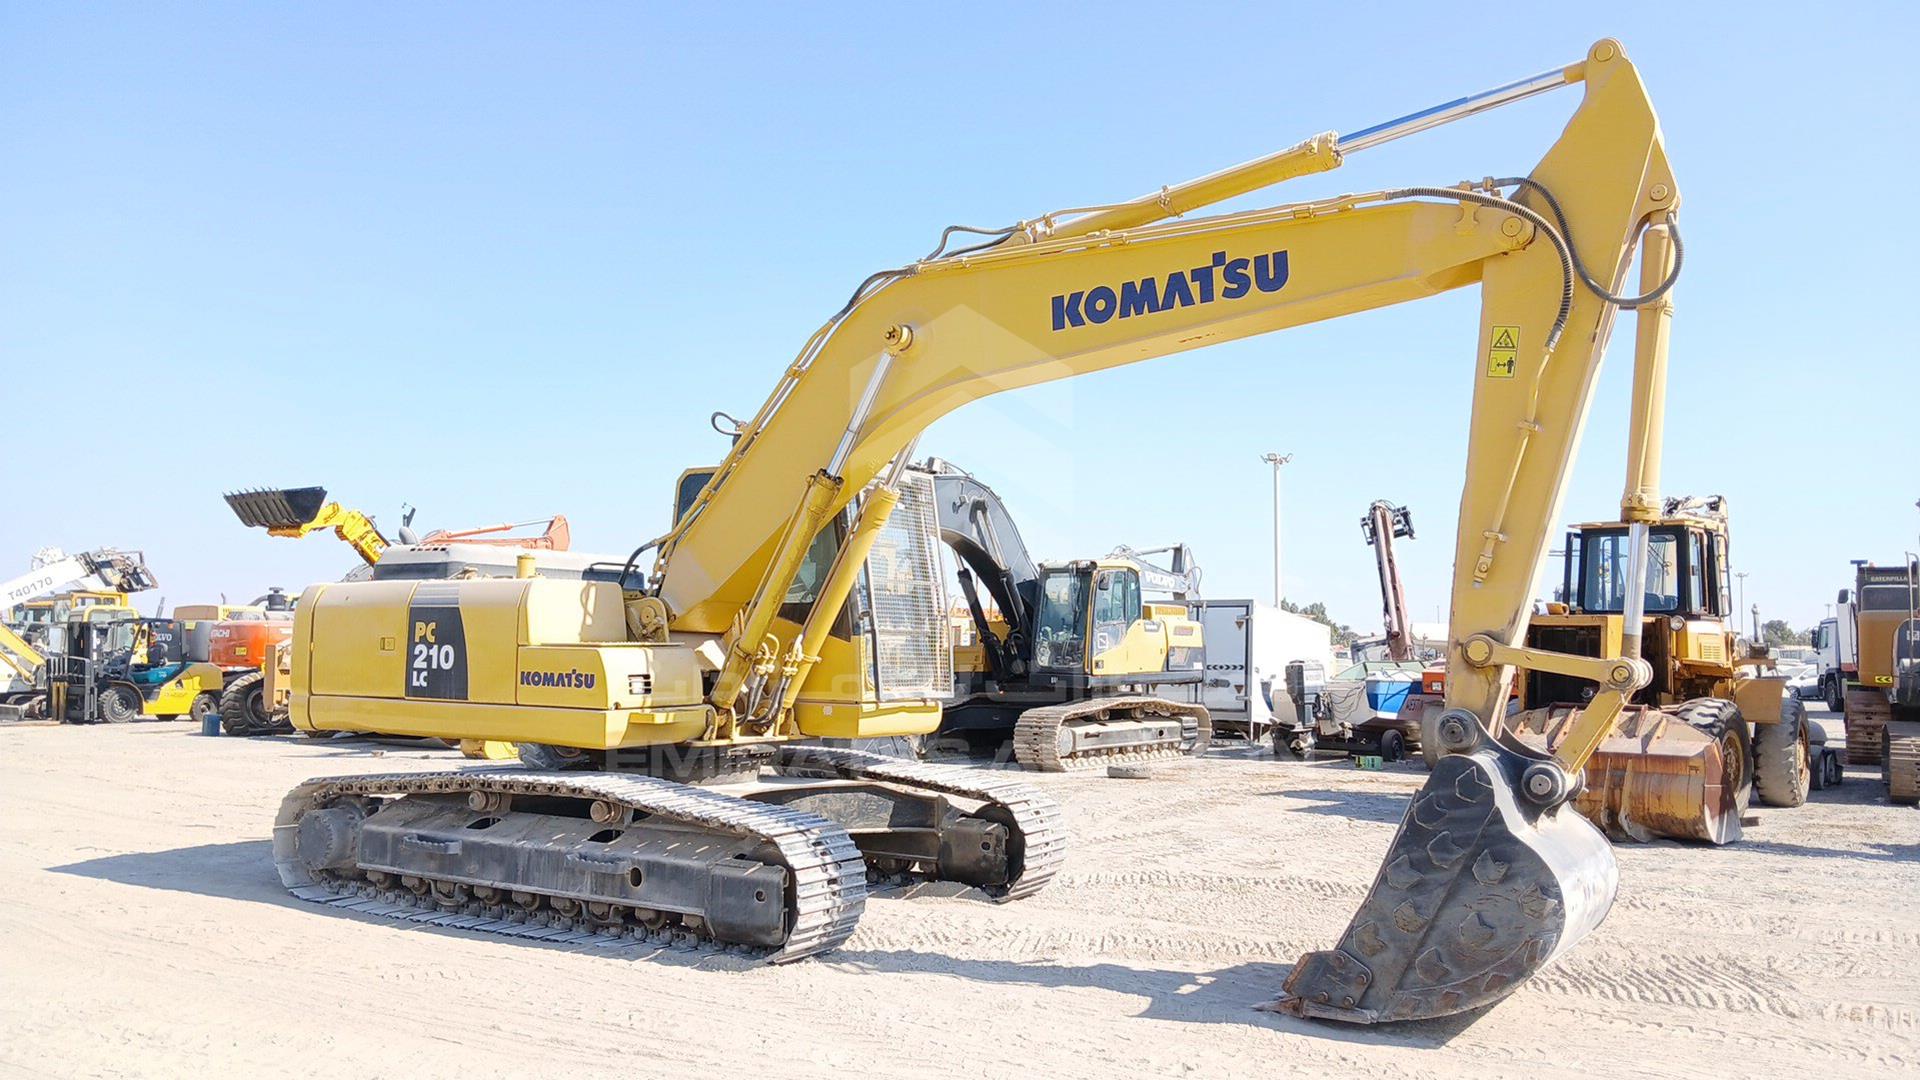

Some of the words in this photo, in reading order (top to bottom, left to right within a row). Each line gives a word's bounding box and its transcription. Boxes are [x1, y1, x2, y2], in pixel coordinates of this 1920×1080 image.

[1051, 250, 1289, 331] KOMATSU
[8, 576, 53, 600] T40170
[414, 622, 437, 643] PC
[413, 643, 454, 671] 210
[412, 671, 428, 687] LC
[520, 669, 595, 690] KOMATSU
